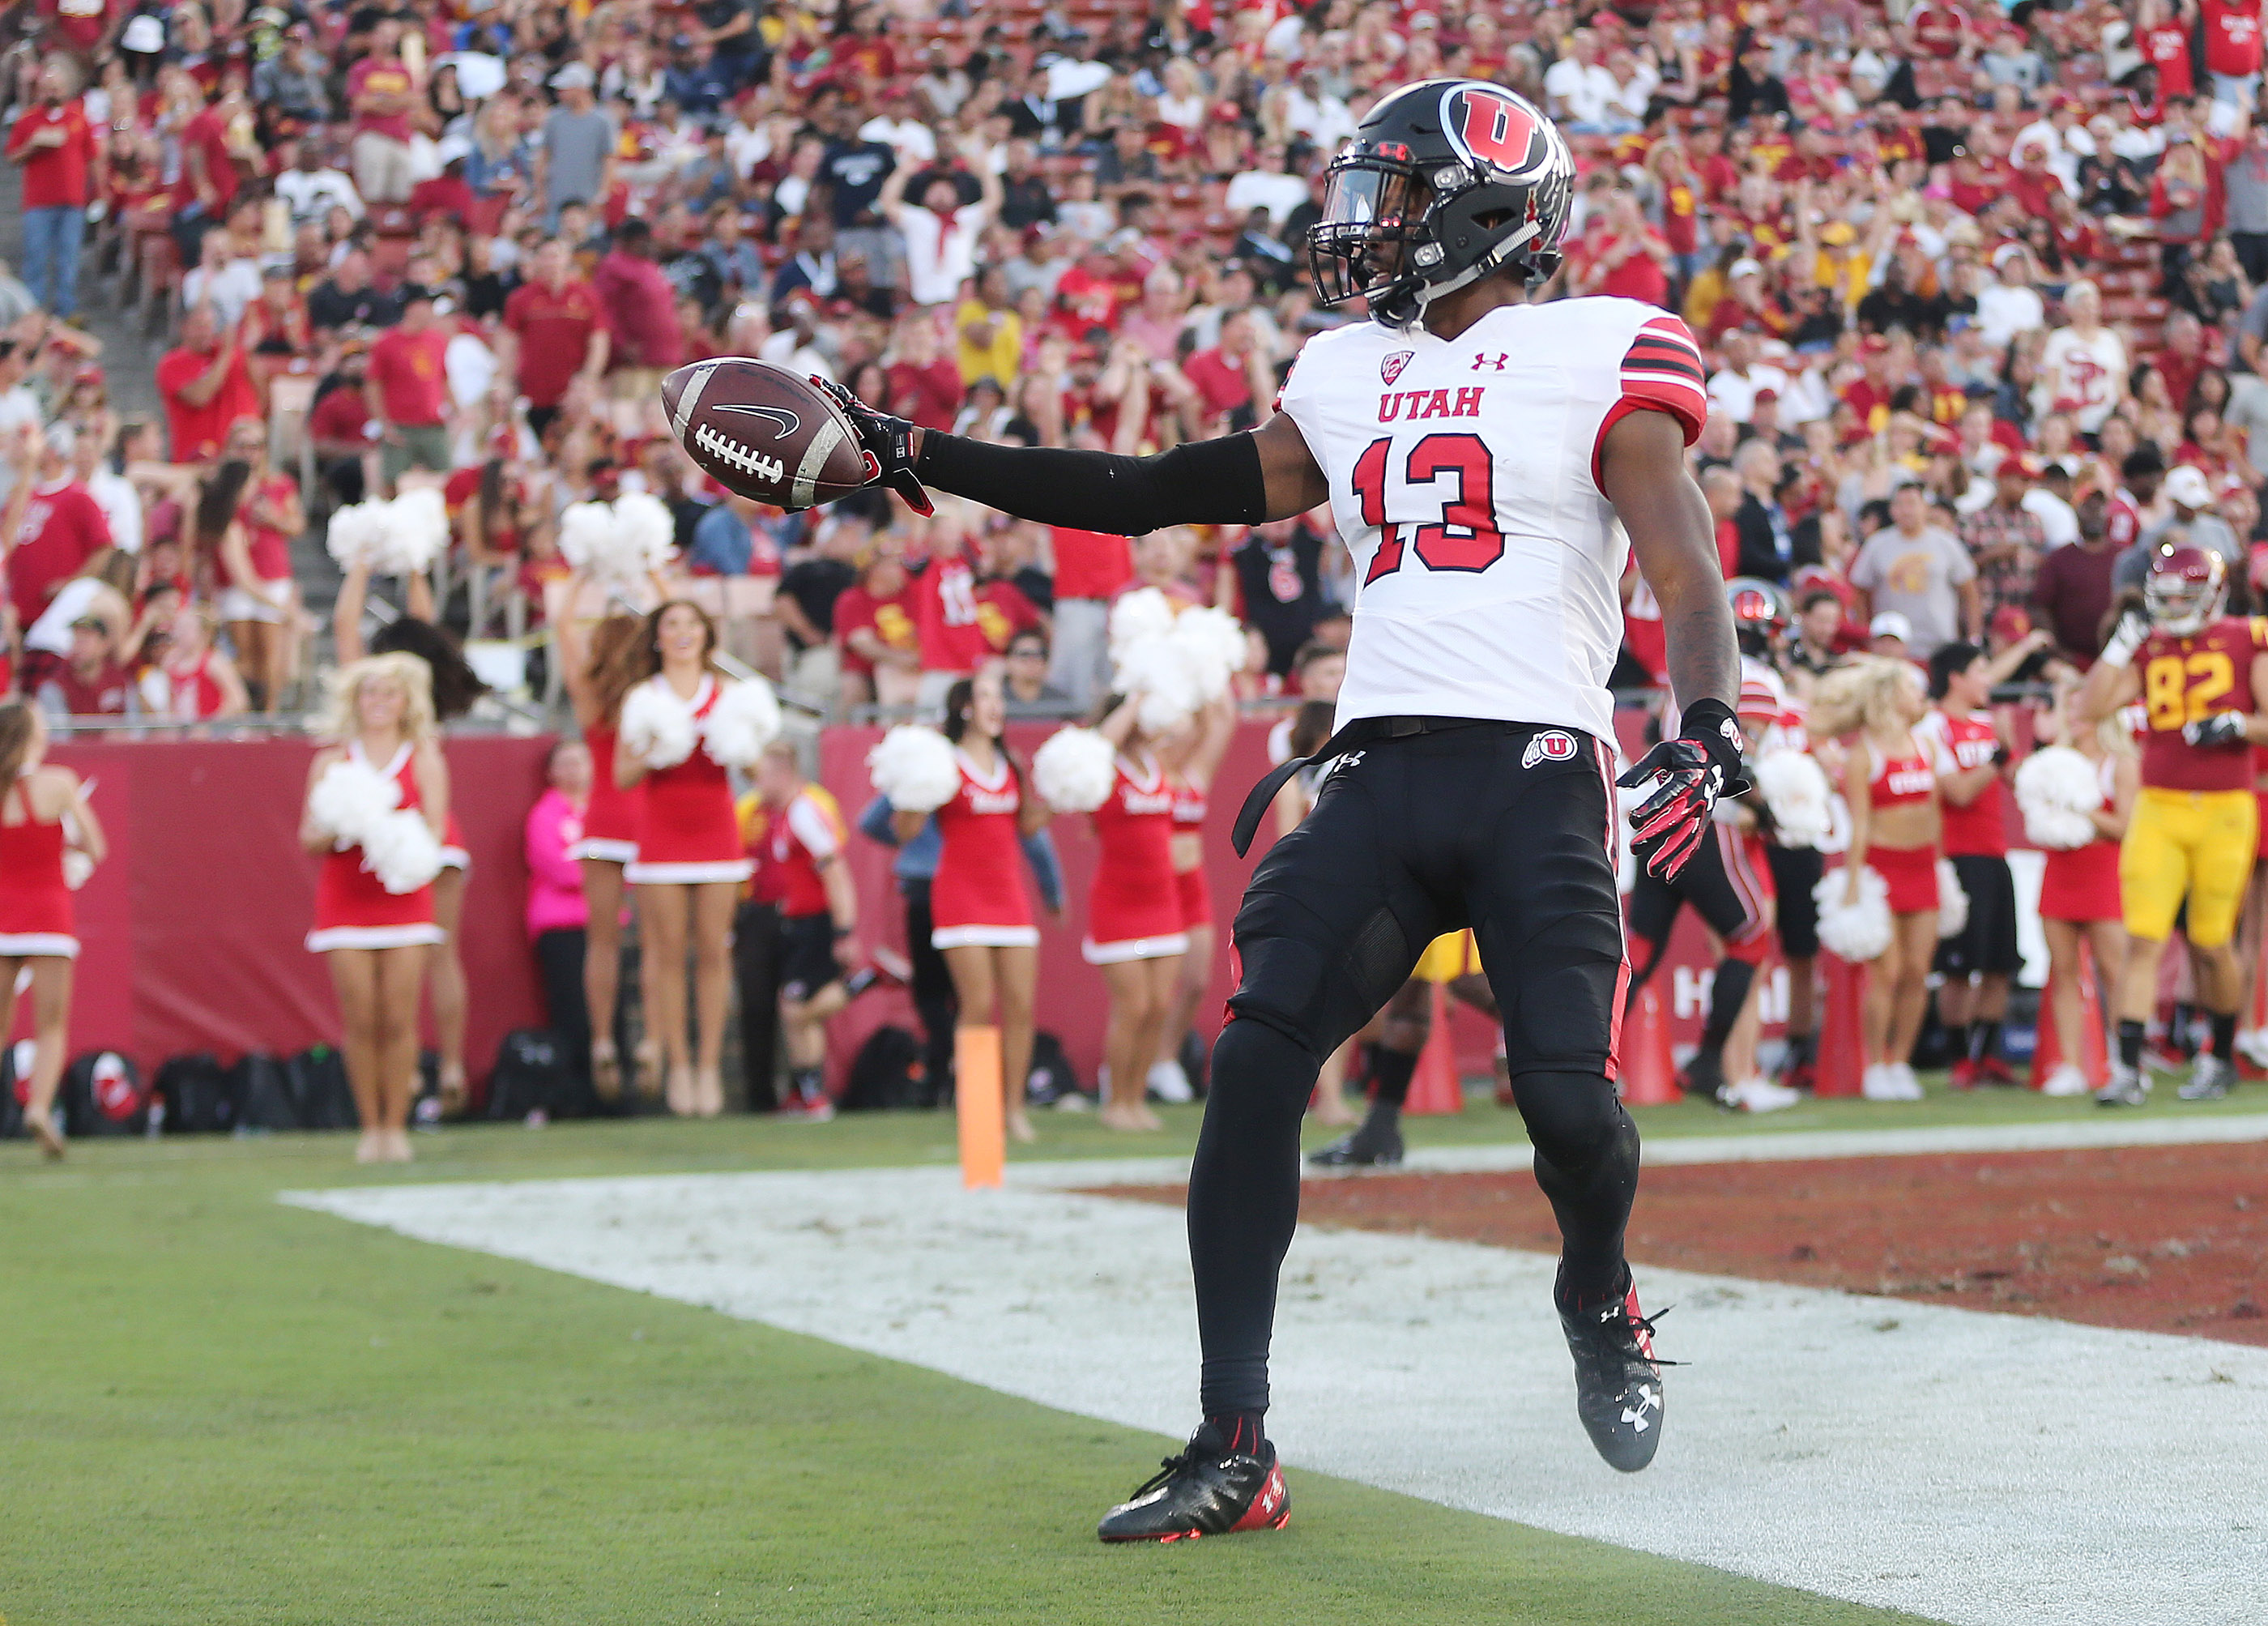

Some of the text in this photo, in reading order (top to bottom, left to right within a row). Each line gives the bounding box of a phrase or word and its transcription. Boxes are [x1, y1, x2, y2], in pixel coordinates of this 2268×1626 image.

[1461, 90, 1538, 173] U
[1379, 386, 1486, 423] UTAH
[1352, 433, 1506, 591] 13
[2146, 651, 2235, 732] 82
[1545, 738, 1567, 755] U
